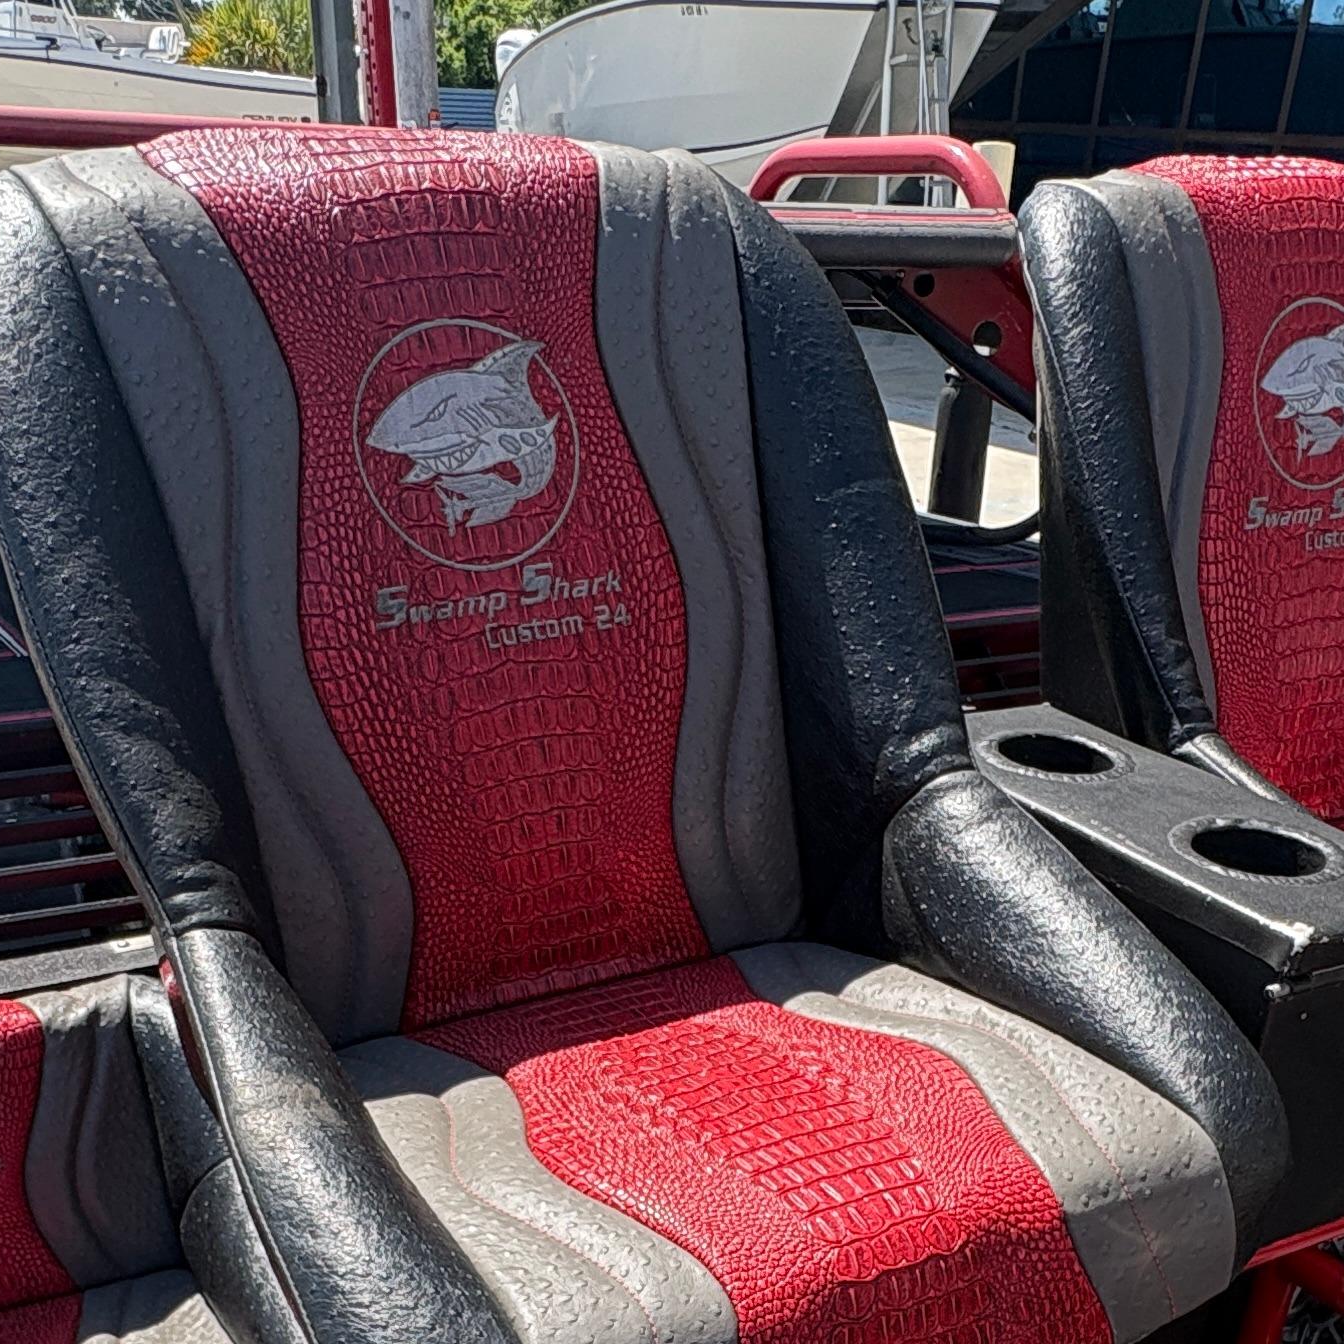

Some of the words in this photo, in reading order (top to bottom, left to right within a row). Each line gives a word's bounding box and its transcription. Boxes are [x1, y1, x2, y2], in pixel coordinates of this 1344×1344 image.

[1244, 497, 1323, 530] Swamp
[376, 585, 507, 630] Swamp
[520, 562, 623, 606] Shark
[485, 615, 584, 650] Custom
[594, 602, 632, 631] 24
